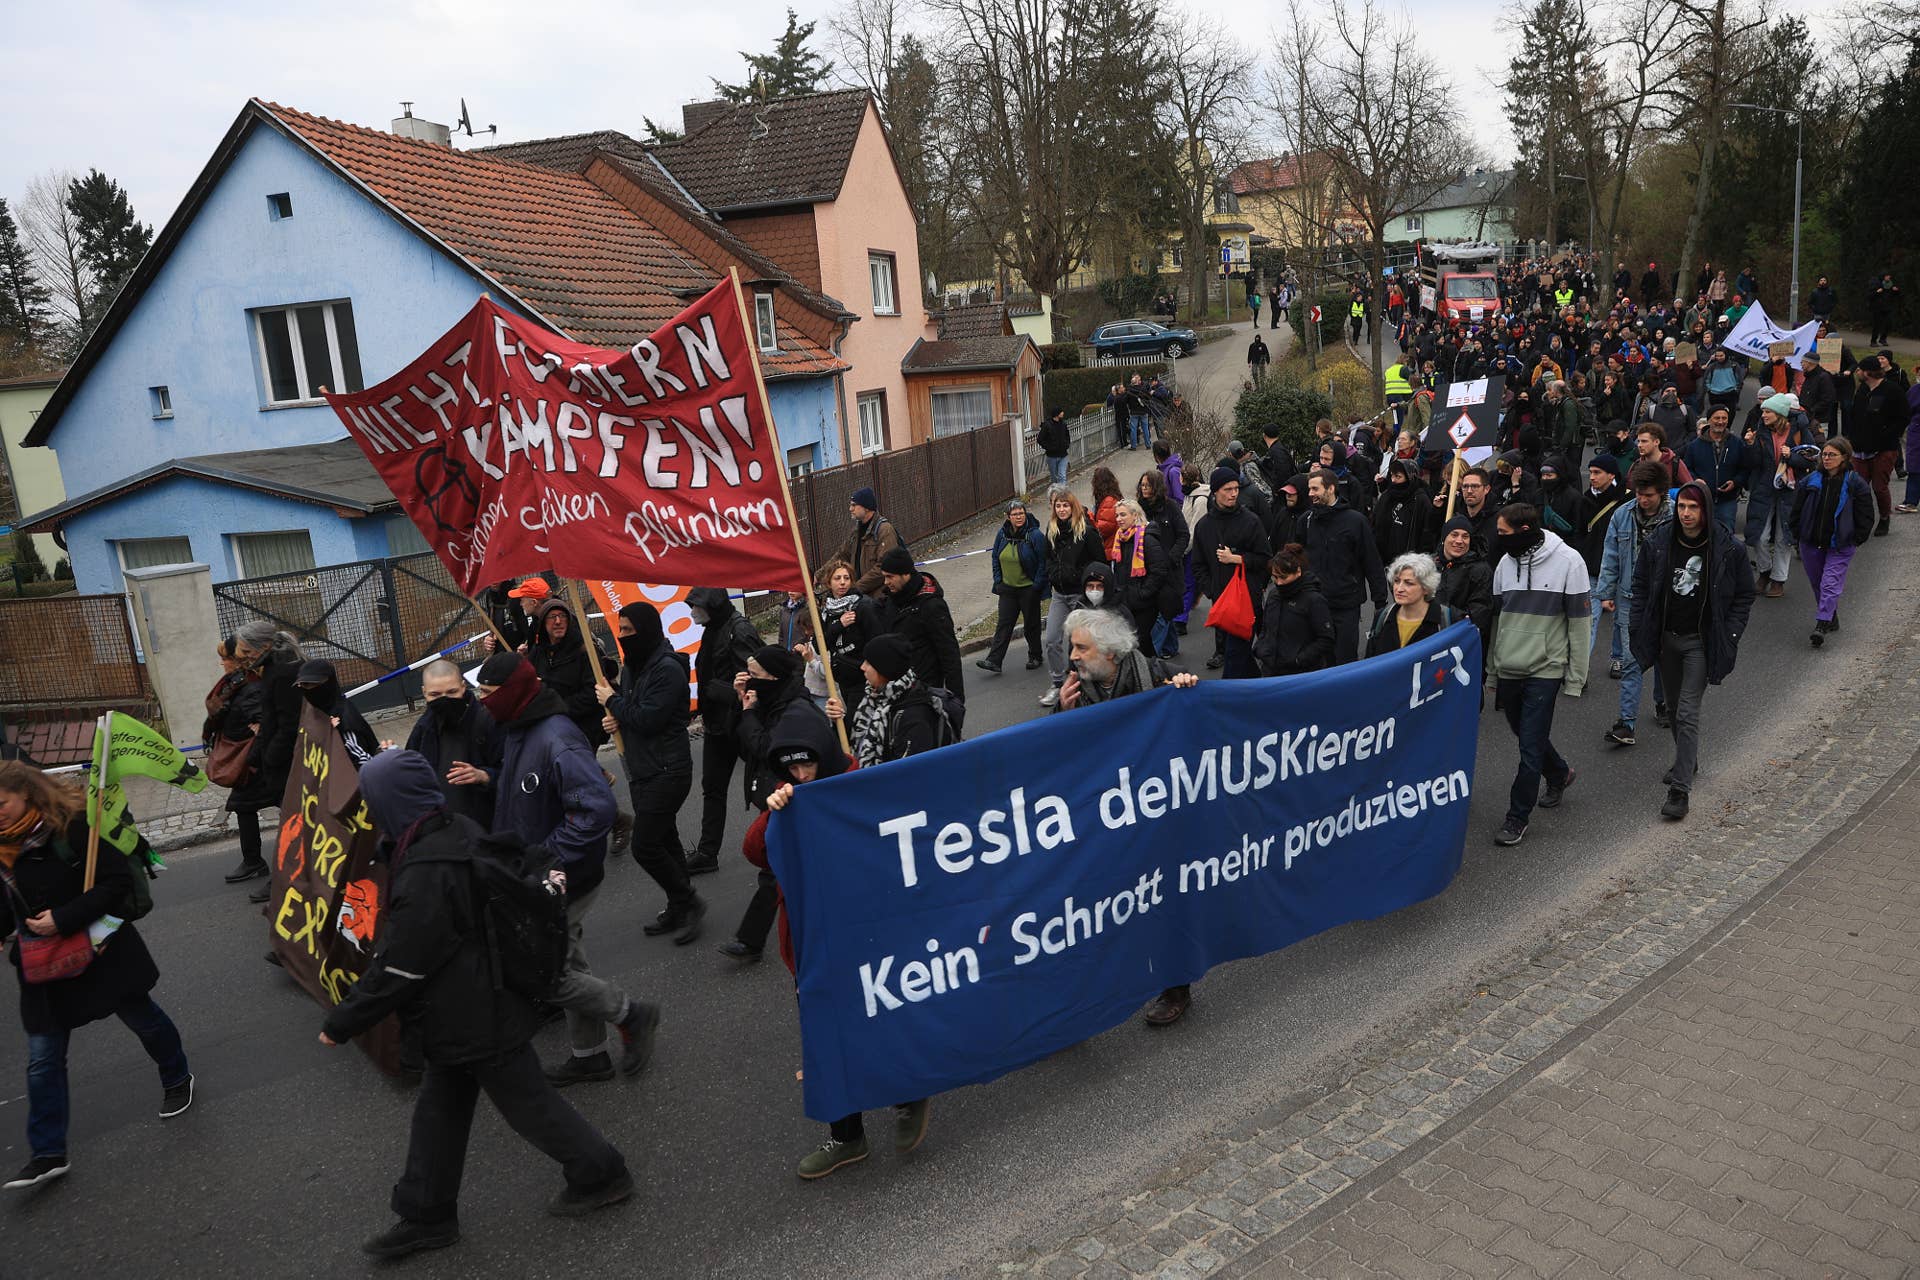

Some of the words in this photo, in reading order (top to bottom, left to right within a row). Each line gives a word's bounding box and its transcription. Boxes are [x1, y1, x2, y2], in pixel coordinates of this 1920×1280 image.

[345, 339, 489, 455] NICHT
[492, 314, 732, 408] FODERN
[462, 392, 764, 490] KÄMPFEN!
[1448, 394, 1486, 406] TESLA
[111, 731, 142, 745] ettet
[144, 739, 175, 756] den
[878, 786, 1076, 888] Tesla
[1098, 715, 1396, 830] deMUSKieren
[1011, 867, 1164, 966] Schrott
[1178, 834, 1275, 894] mehr
[1284, 768, 1470, 870] produzieren
